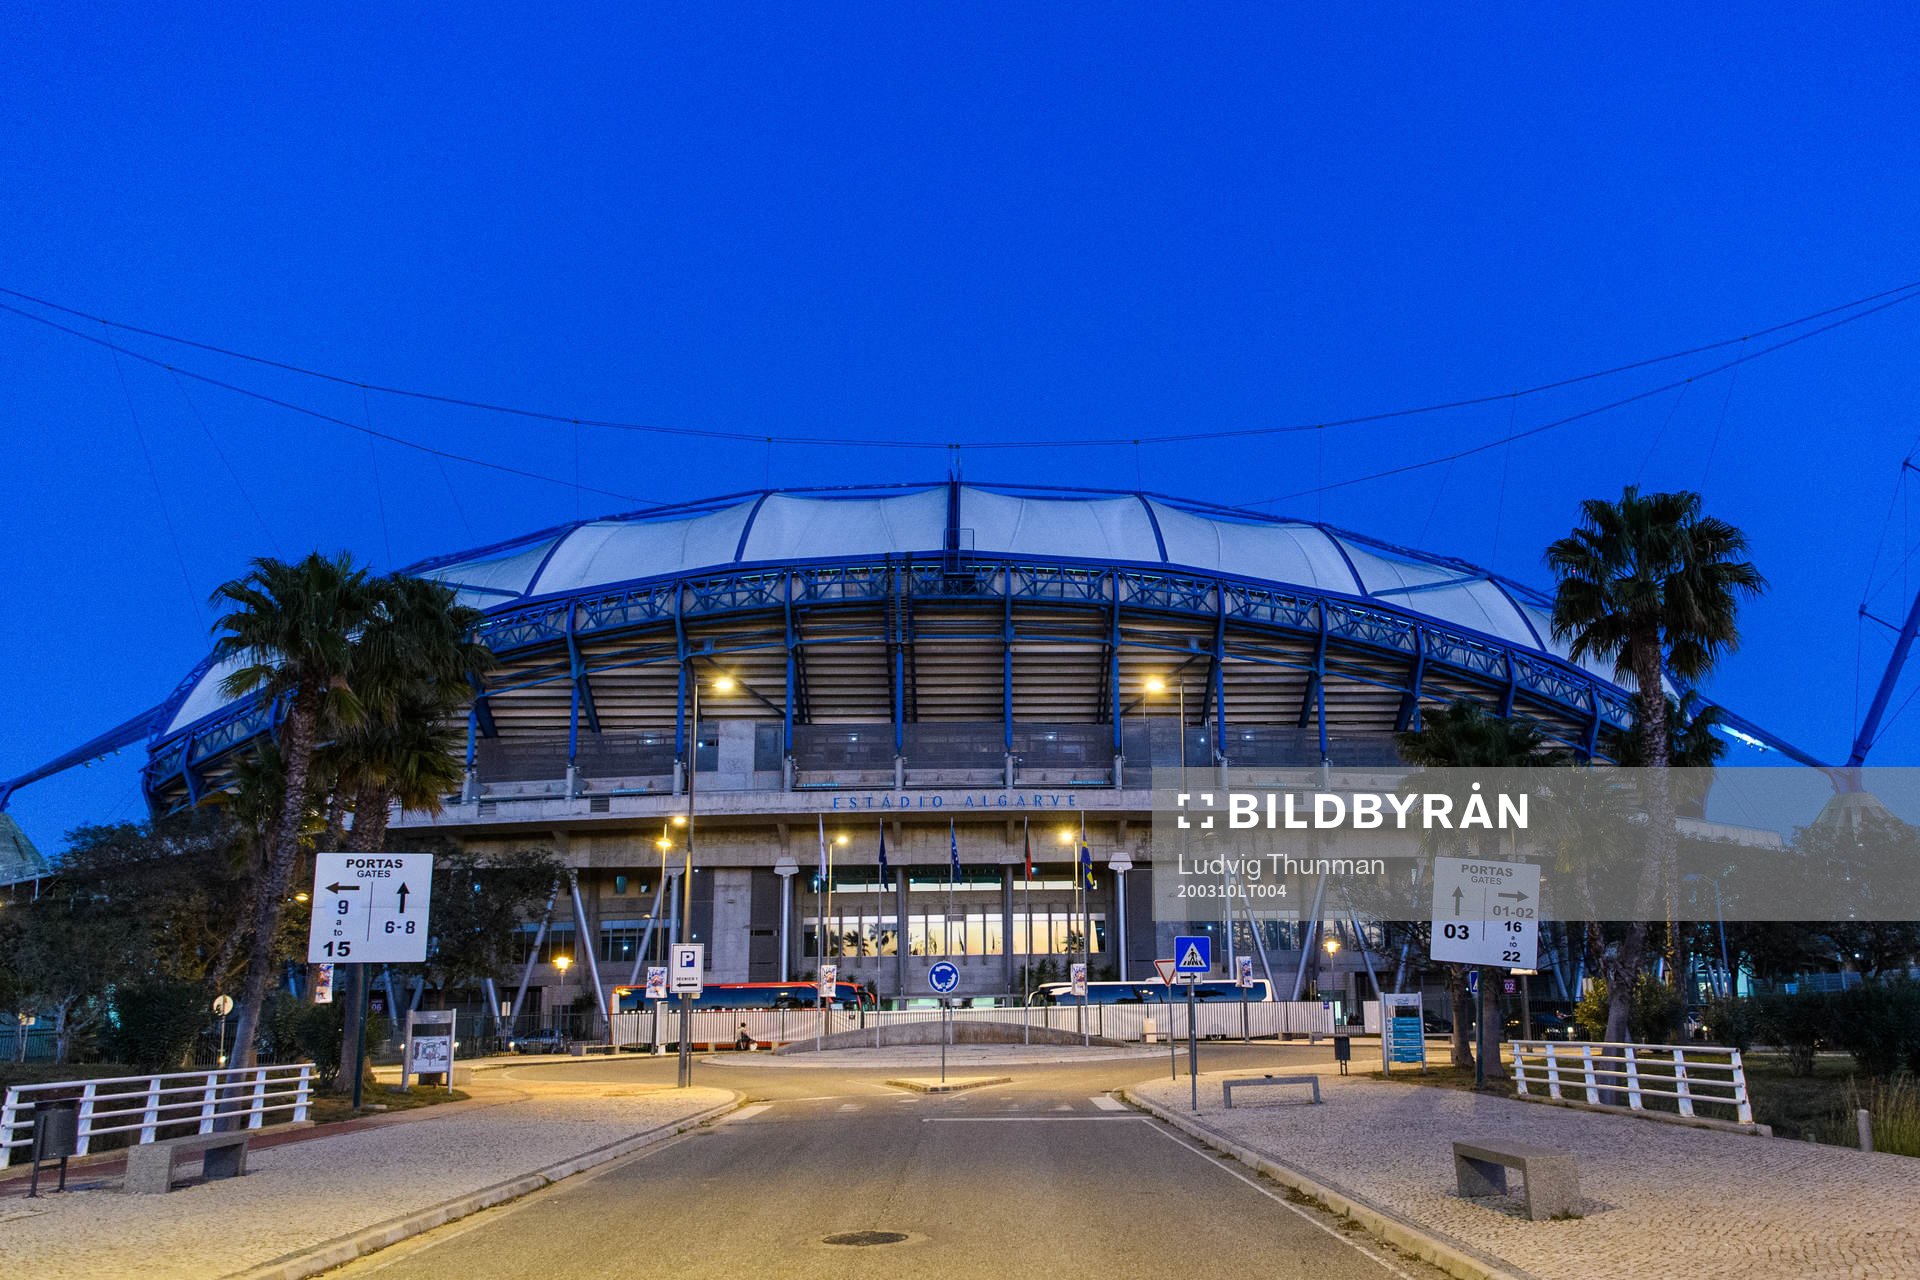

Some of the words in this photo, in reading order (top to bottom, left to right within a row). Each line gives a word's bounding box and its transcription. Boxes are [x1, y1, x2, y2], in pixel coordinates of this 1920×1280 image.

[833, 793, 943, 809] ESTÁDIO
[965, 794, 1076, 808] ALGARVE
[346, 859, 403, 869] PORTAS
[357, 870, 391, 878] GATES
[1461, 864, 1513, 877] PORTAS
[1471, 875, 1502, 886] GATES
[337, 900, 349, 915] 9
[1493, 905, 1534, 919] 01-02
[334, 929, 343, 937] to
[1444, 923, 1470, 940] 03
[1504, 921, 1522, 933] 16
[323, 941, 351, 957] 15
[1502, 951, 1521, 962] 22
